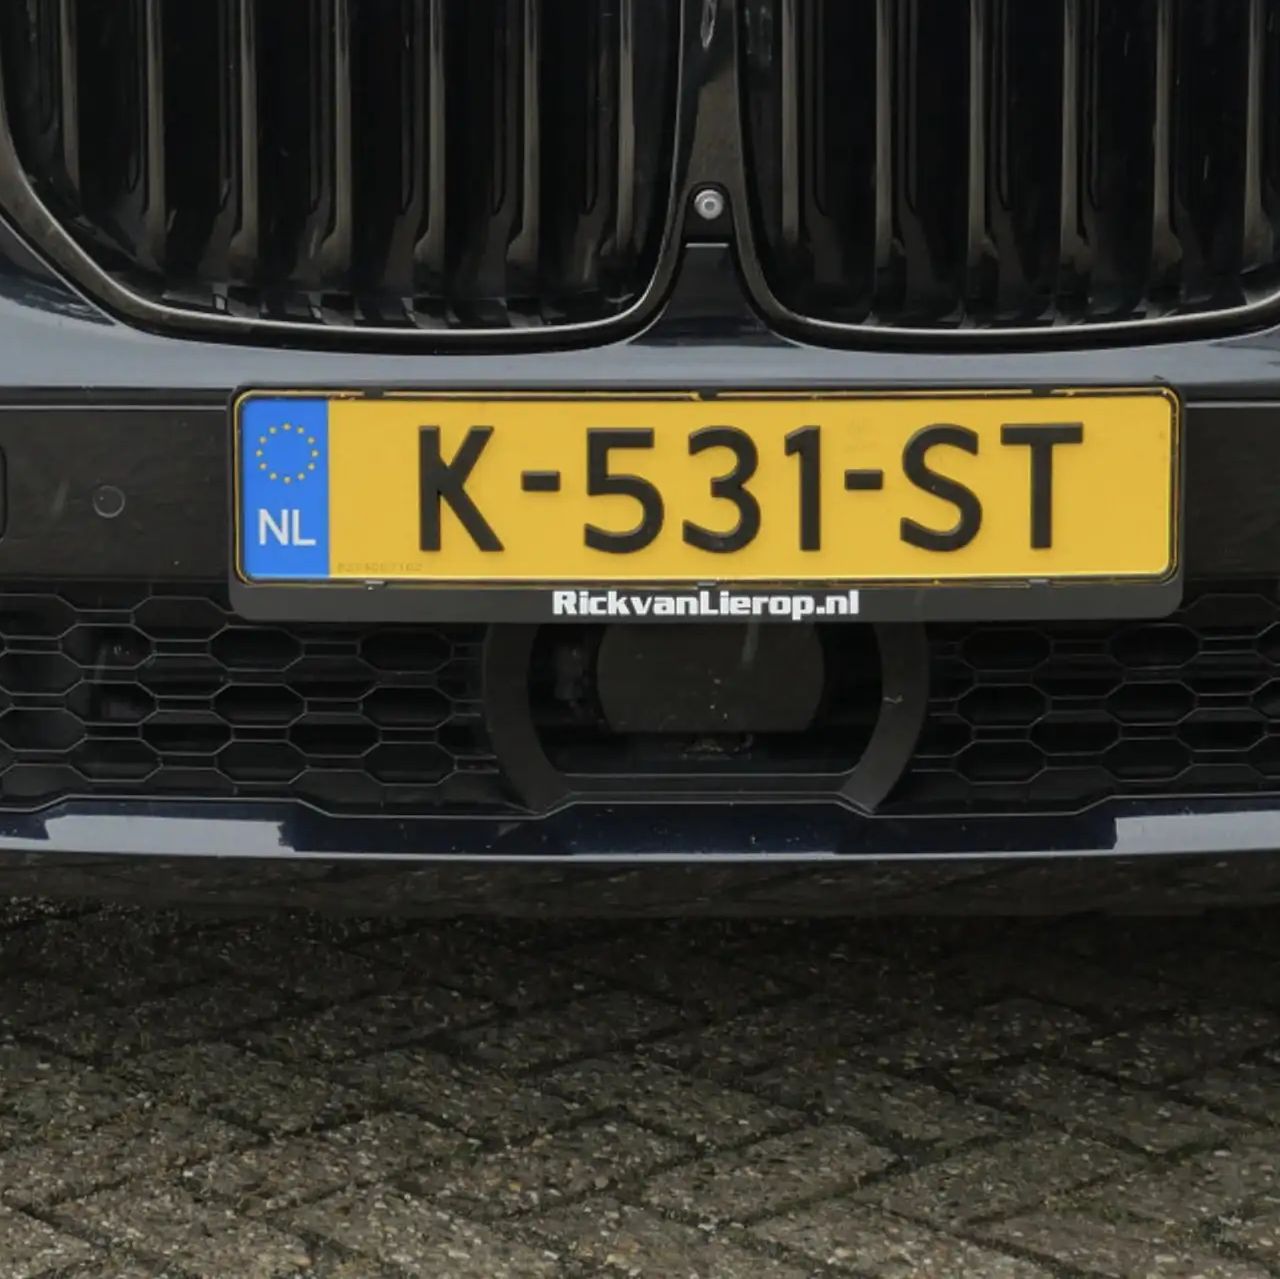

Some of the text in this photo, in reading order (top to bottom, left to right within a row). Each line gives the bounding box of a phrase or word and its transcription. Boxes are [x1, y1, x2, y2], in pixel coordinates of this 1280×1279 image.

[419, 424, 1083, 554] K-531-ST
[260, 509, 315, 545] NL
[553, 590, 859, 620] RickvanLierop.nl
